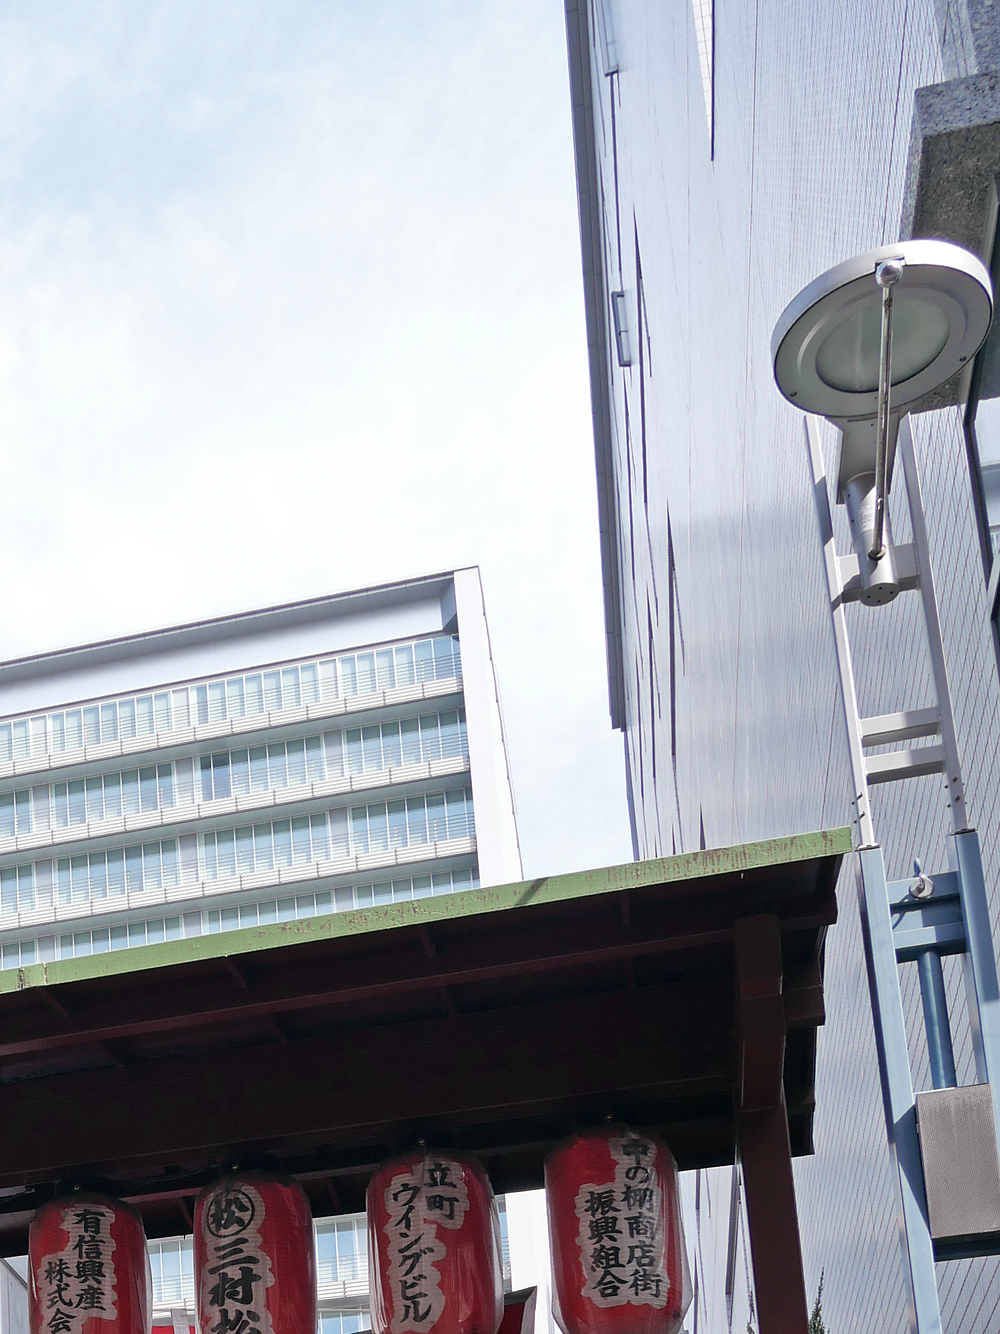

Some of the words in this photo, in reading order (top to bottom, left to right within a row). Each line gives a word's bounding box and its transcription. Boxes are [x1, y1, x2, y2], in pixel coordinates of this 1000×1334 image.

[424, 1161, 459, 1221] 立町
[584, 1188, 629, 1299] 振興組合
[620, 1138, 663, 1299] 中の棚商店街
[72, 1208, 107, 1312] 有信興産
[392, 1182, 435, 1325] ウイングビル
